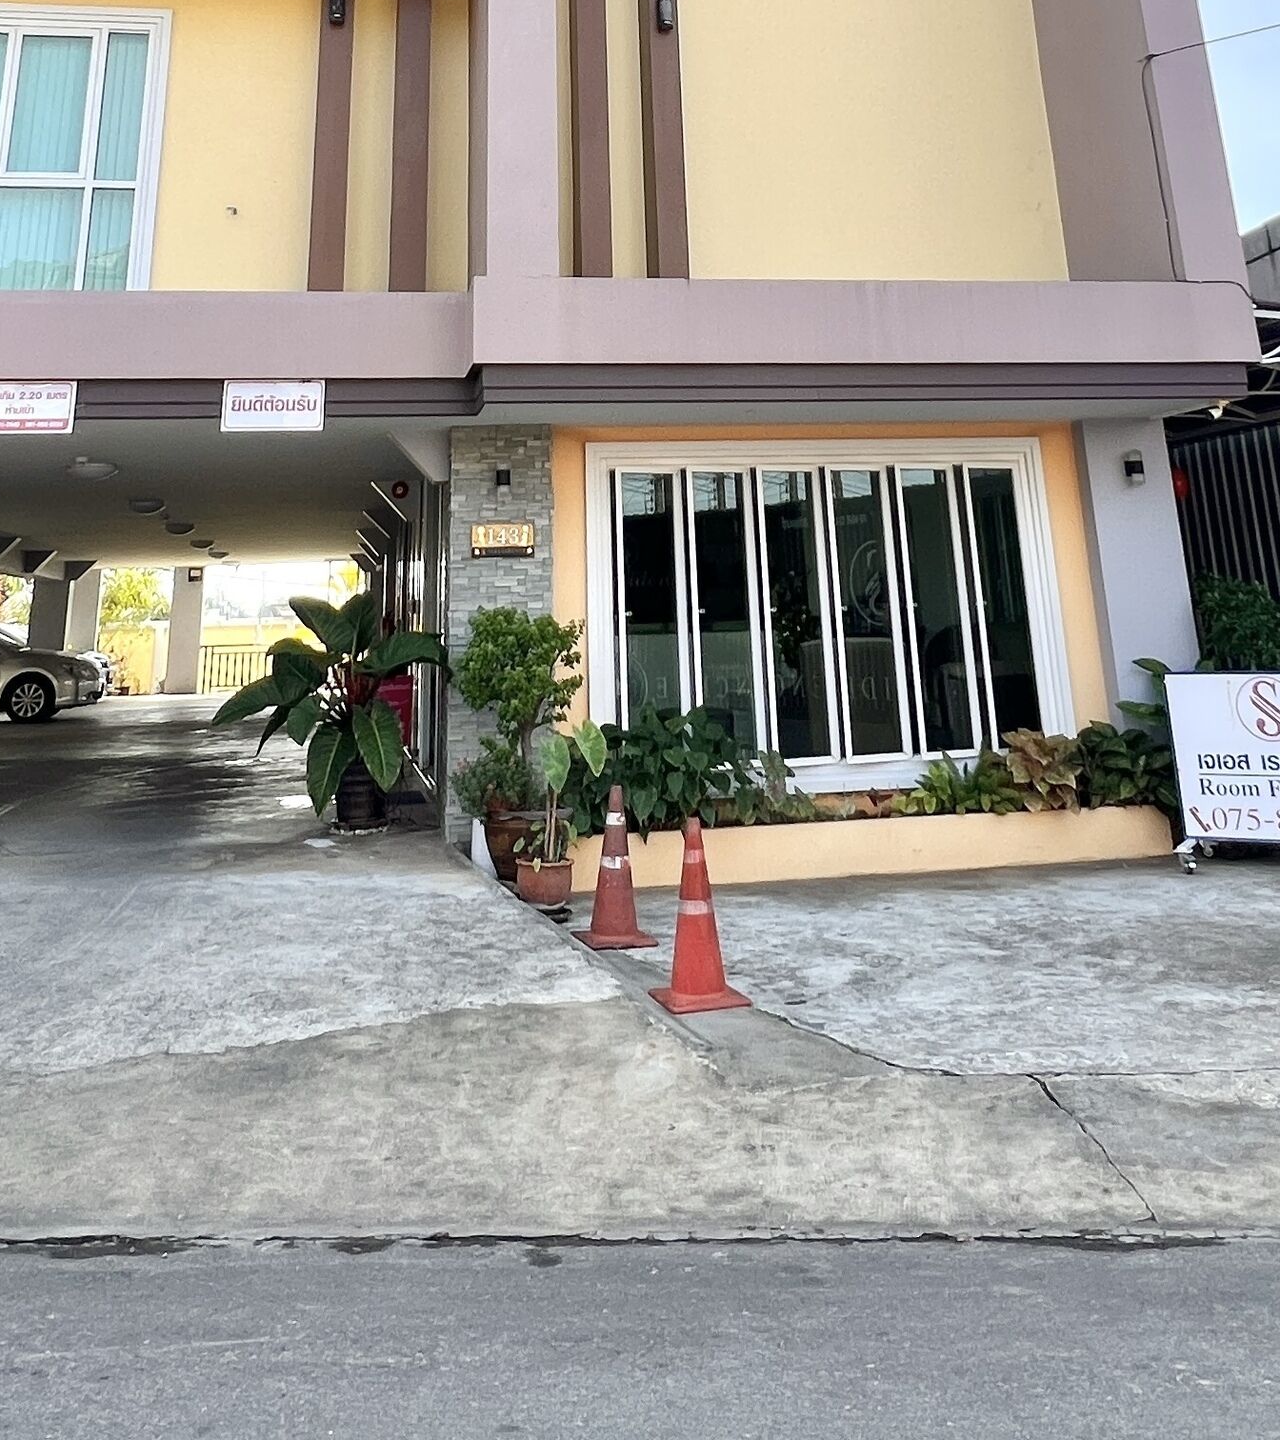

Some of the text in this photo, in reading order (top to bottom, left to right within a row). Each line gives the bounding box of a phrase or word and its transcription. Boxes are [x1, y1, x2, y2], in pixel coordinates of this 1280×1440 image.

[19, 391, 42, 400] 2.20
[231, 394, 317, 412] ยินดีต้อนรับ
[488, 528, 519, 545] 143
[1197, 754, 1251, 770] เจเอส
[1199, 778, 1260, 796] Room
